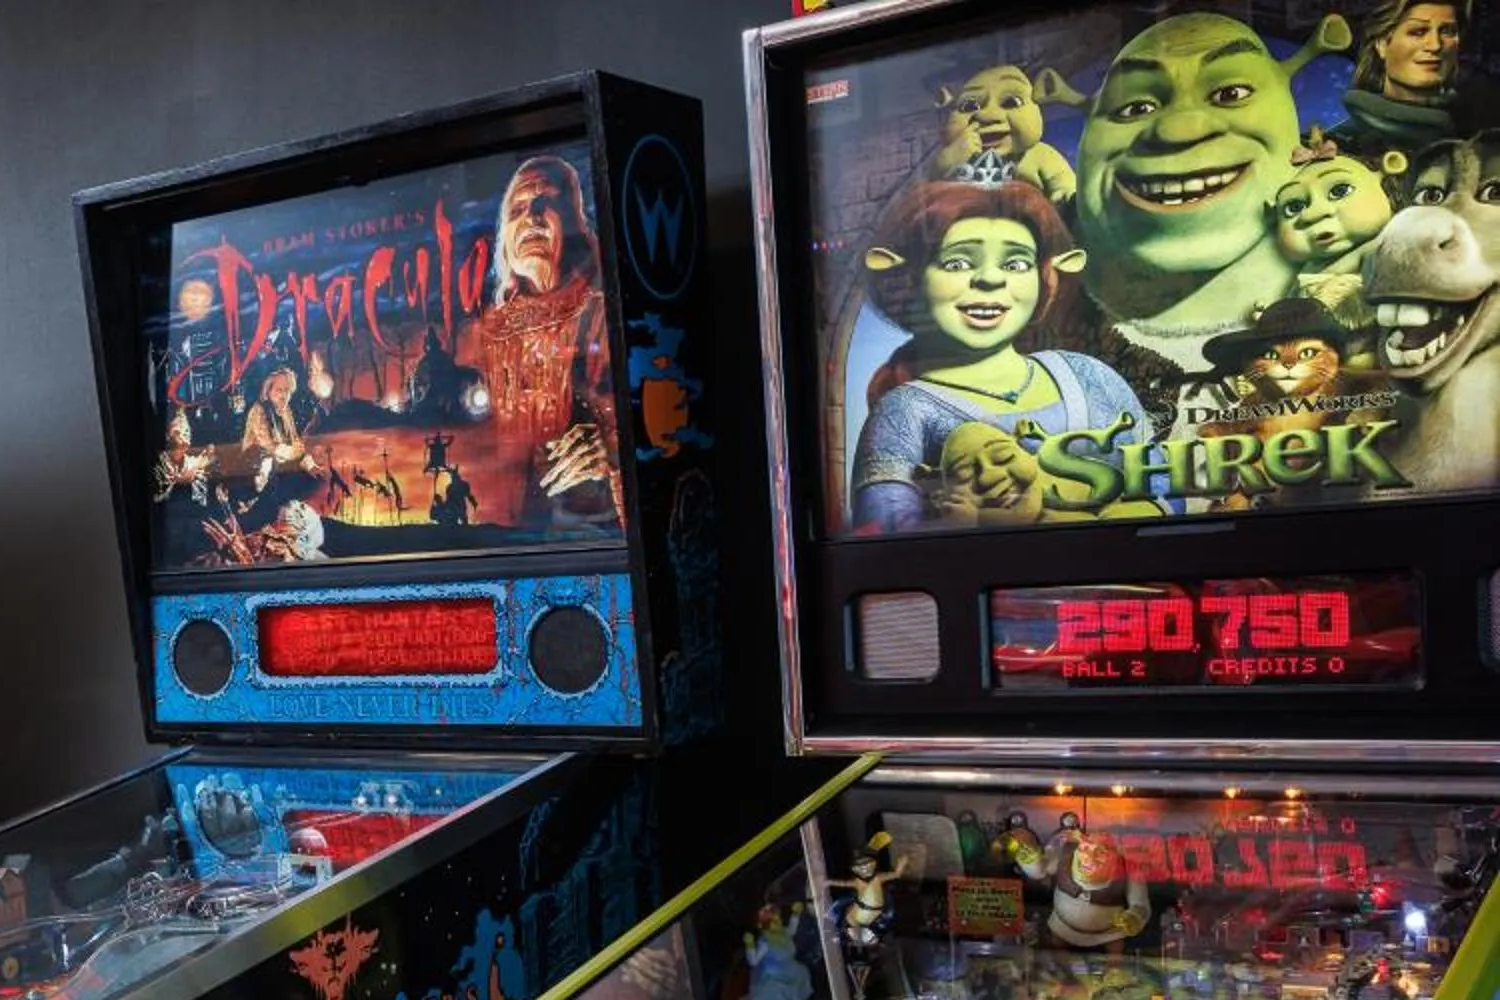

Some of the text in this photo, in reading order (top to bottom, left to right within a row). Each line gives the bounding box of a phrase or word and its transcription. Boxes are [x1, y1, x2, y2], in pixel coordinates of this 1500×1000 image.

[263, 231, 315, 253] BRAM
[1062, 658, 1121, 678] BALL
[1130, 661, 1146, 676] 2
[1209, 657, 1317, 676] CREDITS
